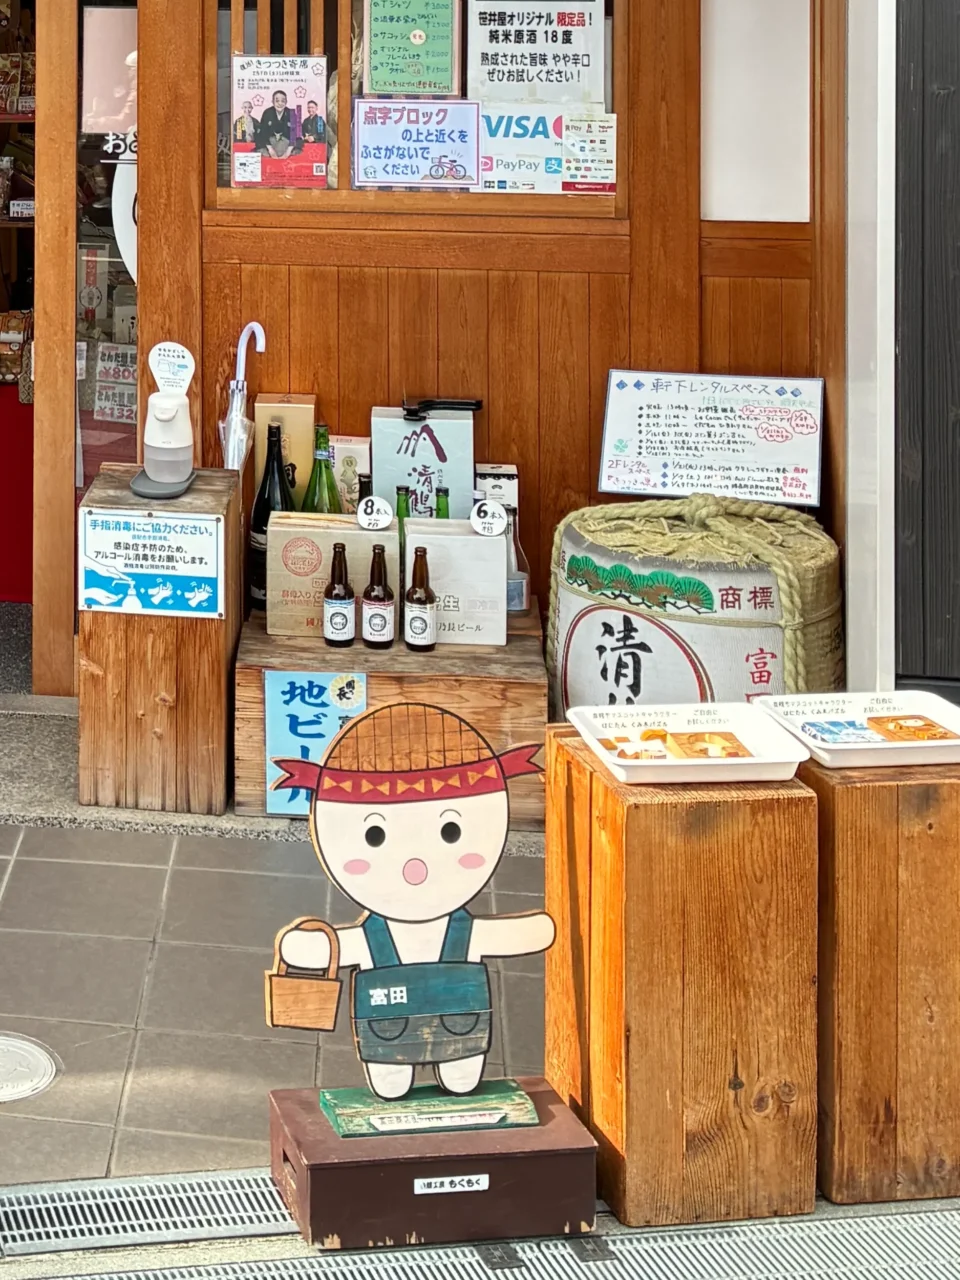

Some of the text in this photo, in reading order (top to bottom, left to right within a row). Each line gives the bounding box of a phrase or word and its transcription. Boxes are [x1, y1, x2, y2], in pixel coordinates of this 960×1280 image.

[478, 11, 555, 27] 笹井屋オリジナル
[488, 30, 538, 45] 純米原酒
[480, 52, 591, 67] 熟成された旨味 やや辛口
[363, 105, 449, 126] 点字ブロック
[481, 114, 551, 139] VISA
[401, 128, 469, 144] の上と近くを
[360, 144, 431, 161] ふさがないで
[382, 163, 420, 176] ください
[496, 159, 541, 172] PayPay
[650, 377, 771, 396] 軒下レンタルスペース
[89, 518, 213, 537] 手指消毒にご協力ください。
[113, 541, 188, 554] 感染症予防のため、
[94, 550, 208, 566] アルコール消毒をお願いします。
[719, 585, 775, 611] 商標
[595, 614, 653, 705] 清
[745, 648, 778, 703] 富
[369, 987, 408, 1006] 富田
[448, 1177, 481, 1189] もくもく
